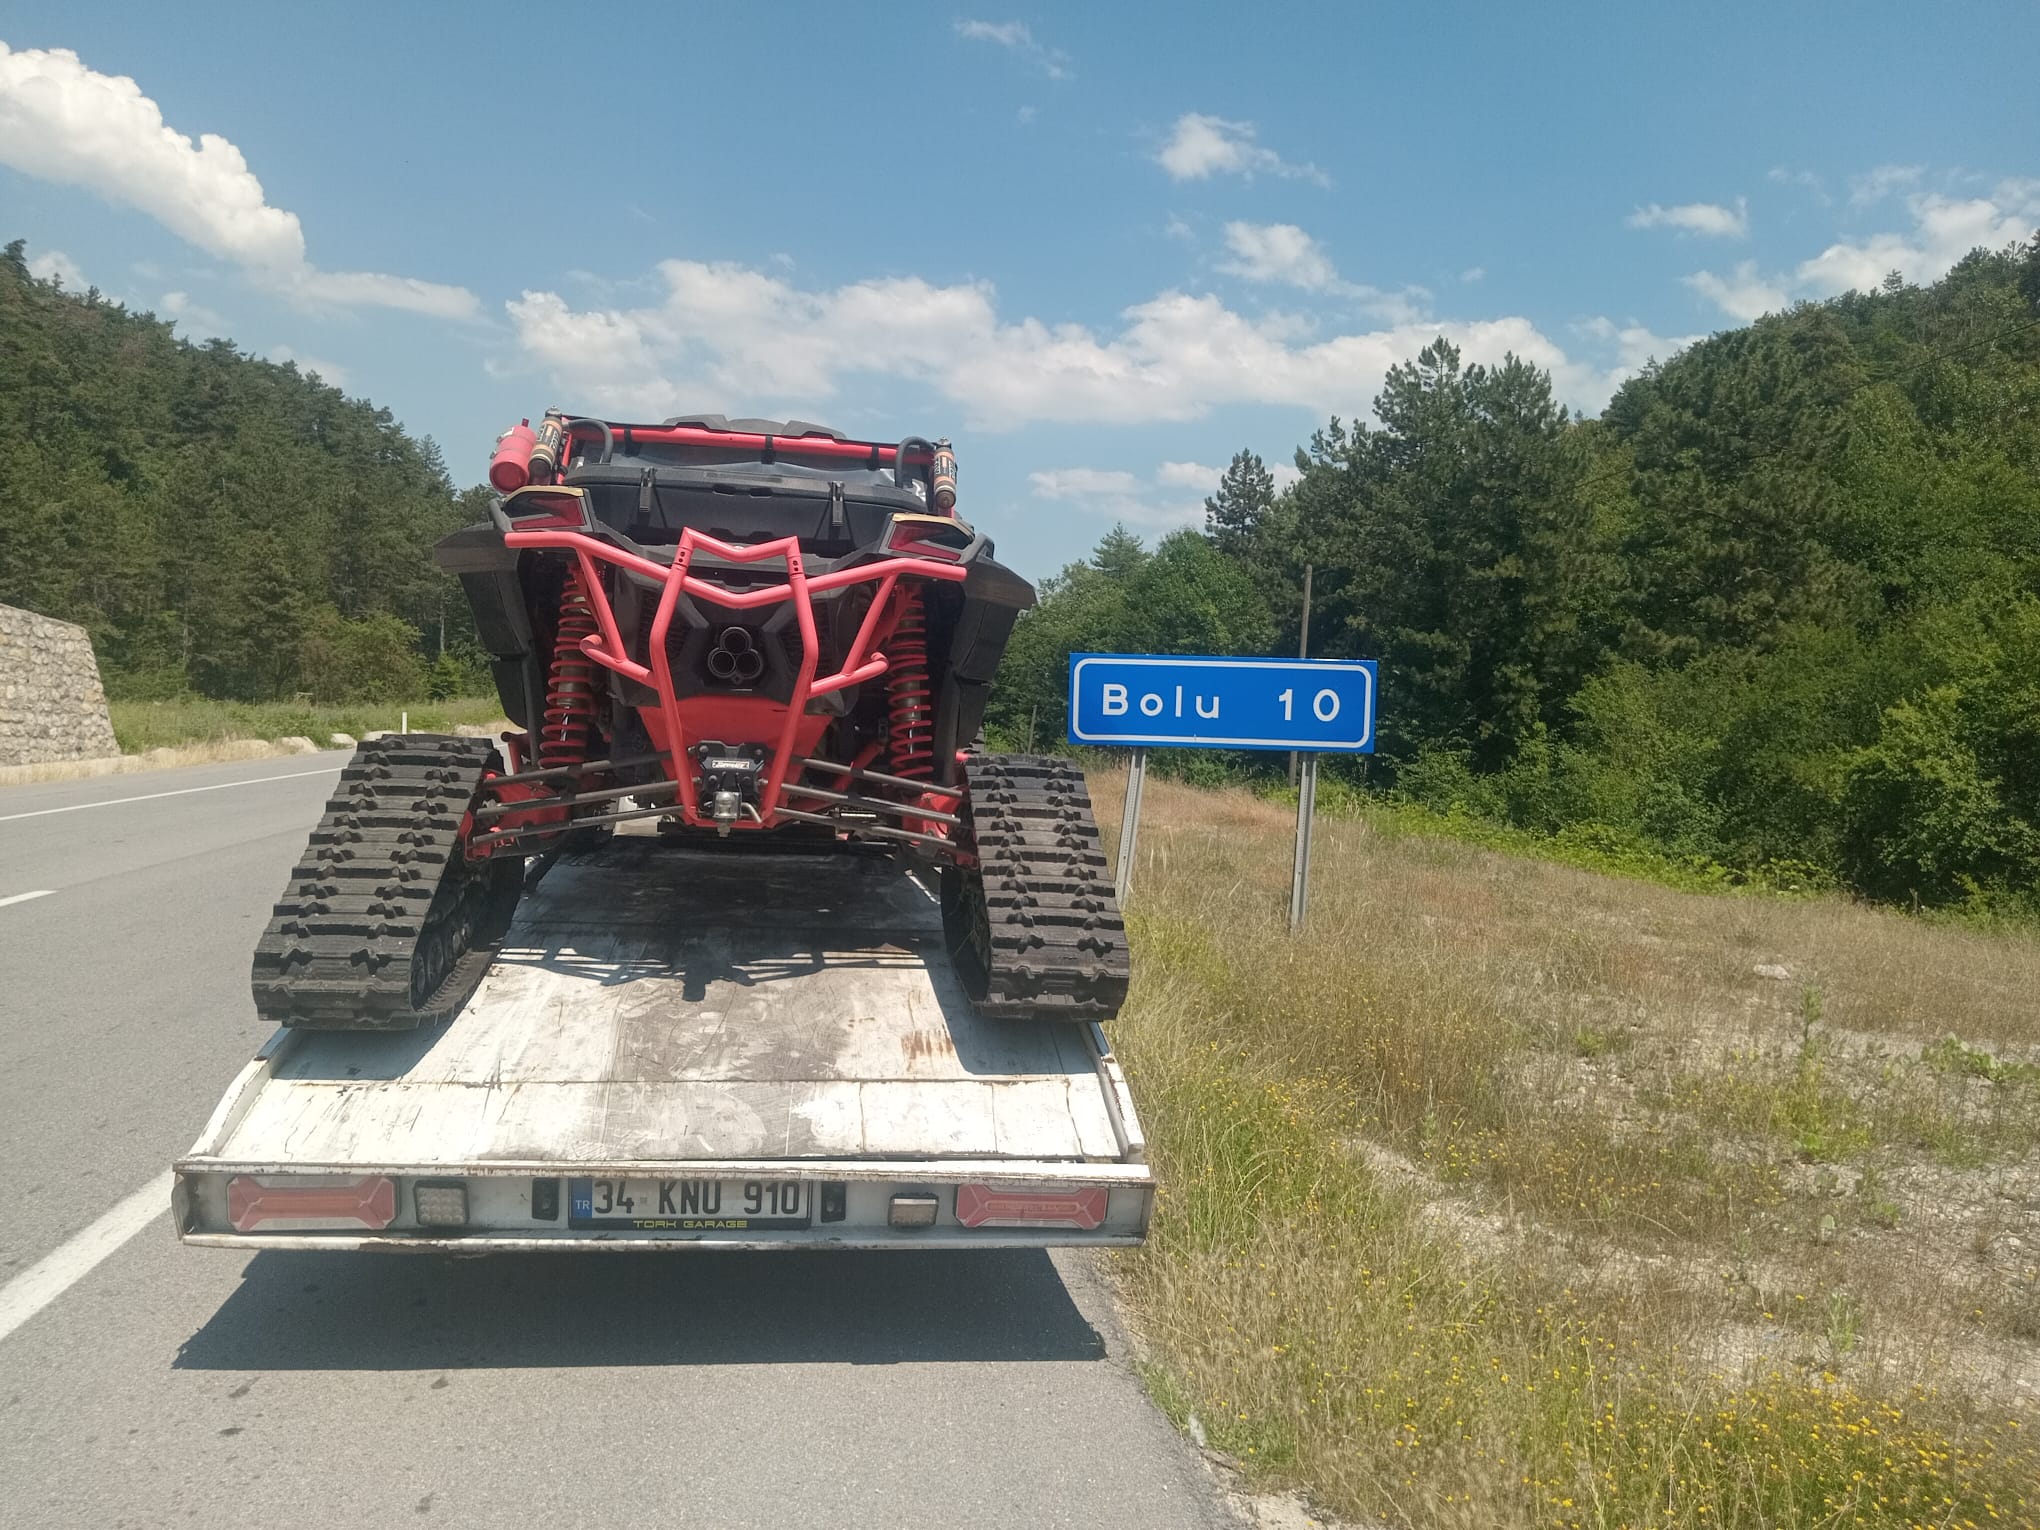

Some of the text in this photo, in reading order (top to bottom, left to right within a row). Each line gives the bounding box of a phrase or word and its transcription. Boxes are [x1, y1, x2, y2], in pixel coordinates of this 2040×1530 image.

[1102, 683, 1341, 722] Bolu 10
[575, 1199, 591, 1210] TR
[594, 1180, 801, 1215] 34 KNU 910
[632, 1219, 749, 1229] TORK GARAGE
